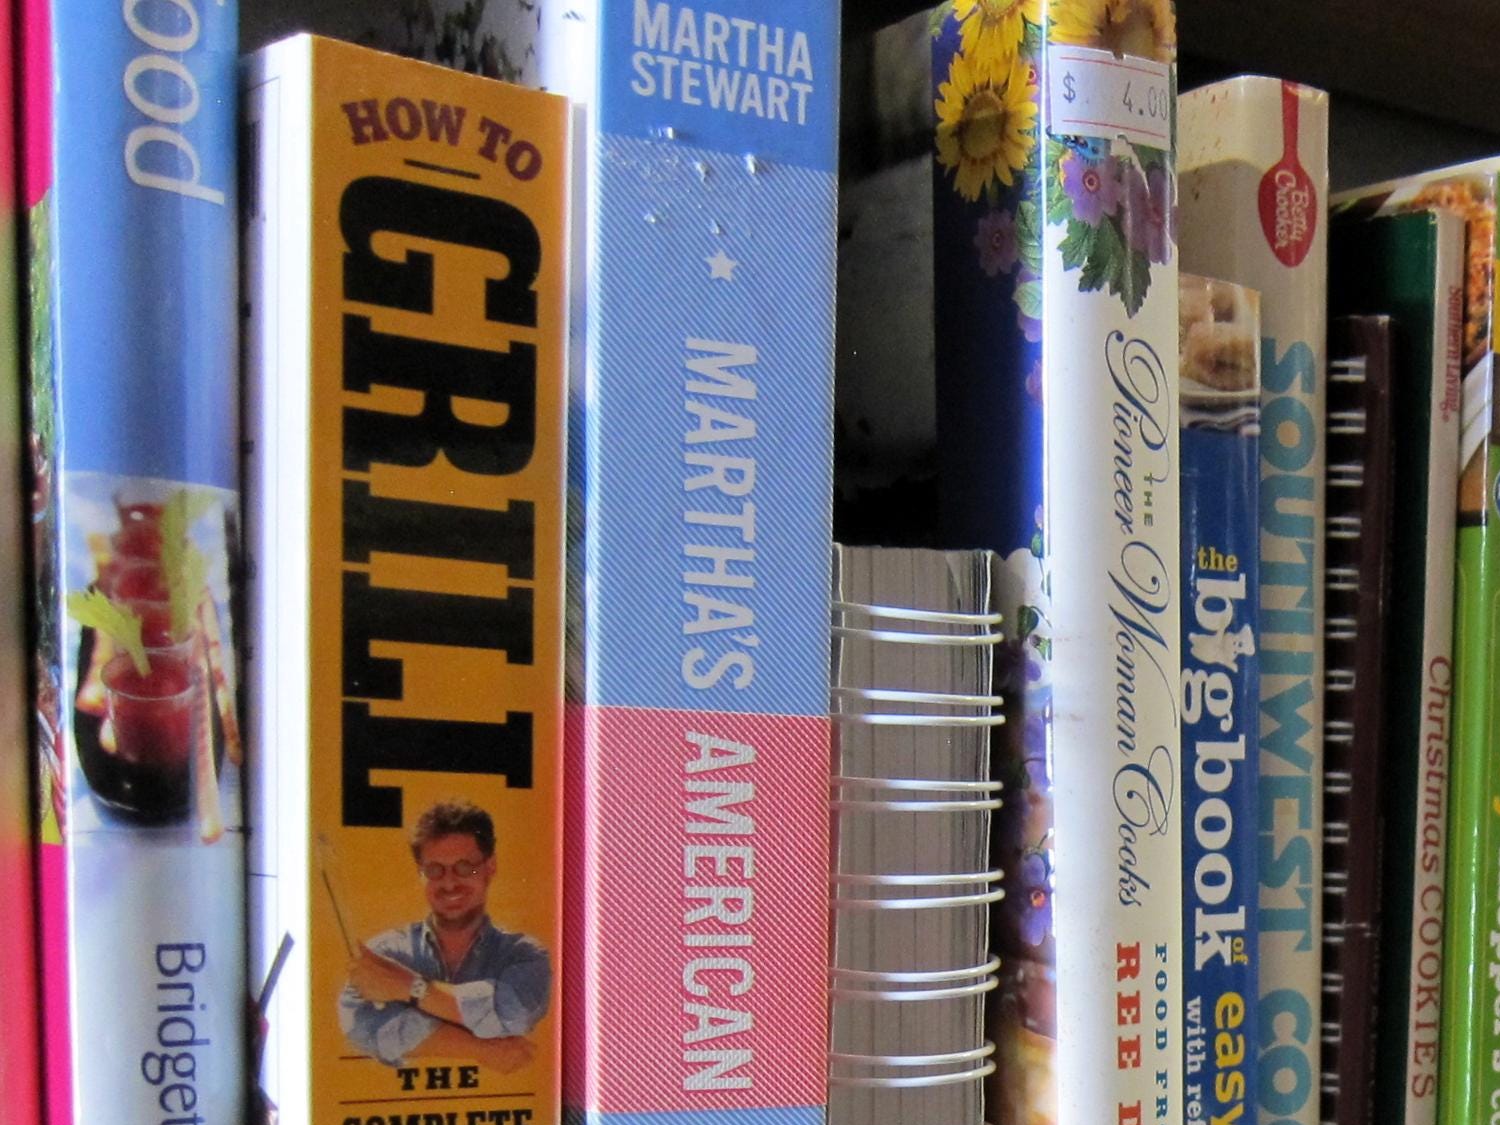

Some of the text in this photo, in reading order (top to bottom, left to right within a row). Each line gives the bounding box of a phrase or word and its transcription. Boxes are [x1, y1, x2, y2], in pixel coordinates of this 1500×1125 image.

[634, 2, 814, 80] MARTHA
[124, 0, 224, 206] ood
[631, 55, 814, 127] STEWART
[1062, 72, 1168, 119] $ 4.00
[342, 97, 542, 182] HOW TO
[1273, 169, 1297, 249] Crocker
[1290, 187, 1311, 246] Betty
[1440, 286, 1464, 413] Southern Living
[339, 175, 543, 828] GRILL
[682, 336, 758, 693] MARTHA'S
[1144, 473, 1154, 527] THE
[1198, 546, 1238, 572] the
[1105, 330, 1178, 907] Pioneer Woman Cooks
[1258, 337, 1317, 953] SOUTHWEST
[1194, 735, 1247, 971] book
[1411, 655, 1452, 1099] Christmas COOKIES
[682, 730, 756, 1092] AMERICAN
[1231, 937, 1248, 964] of
[1116, 942, 1142, 1070] REE
[1155, 944, 1168, 1051] FOOD
[1186, 997, 1201, 1075] with
[398, 1067, 480, 1091] THE
